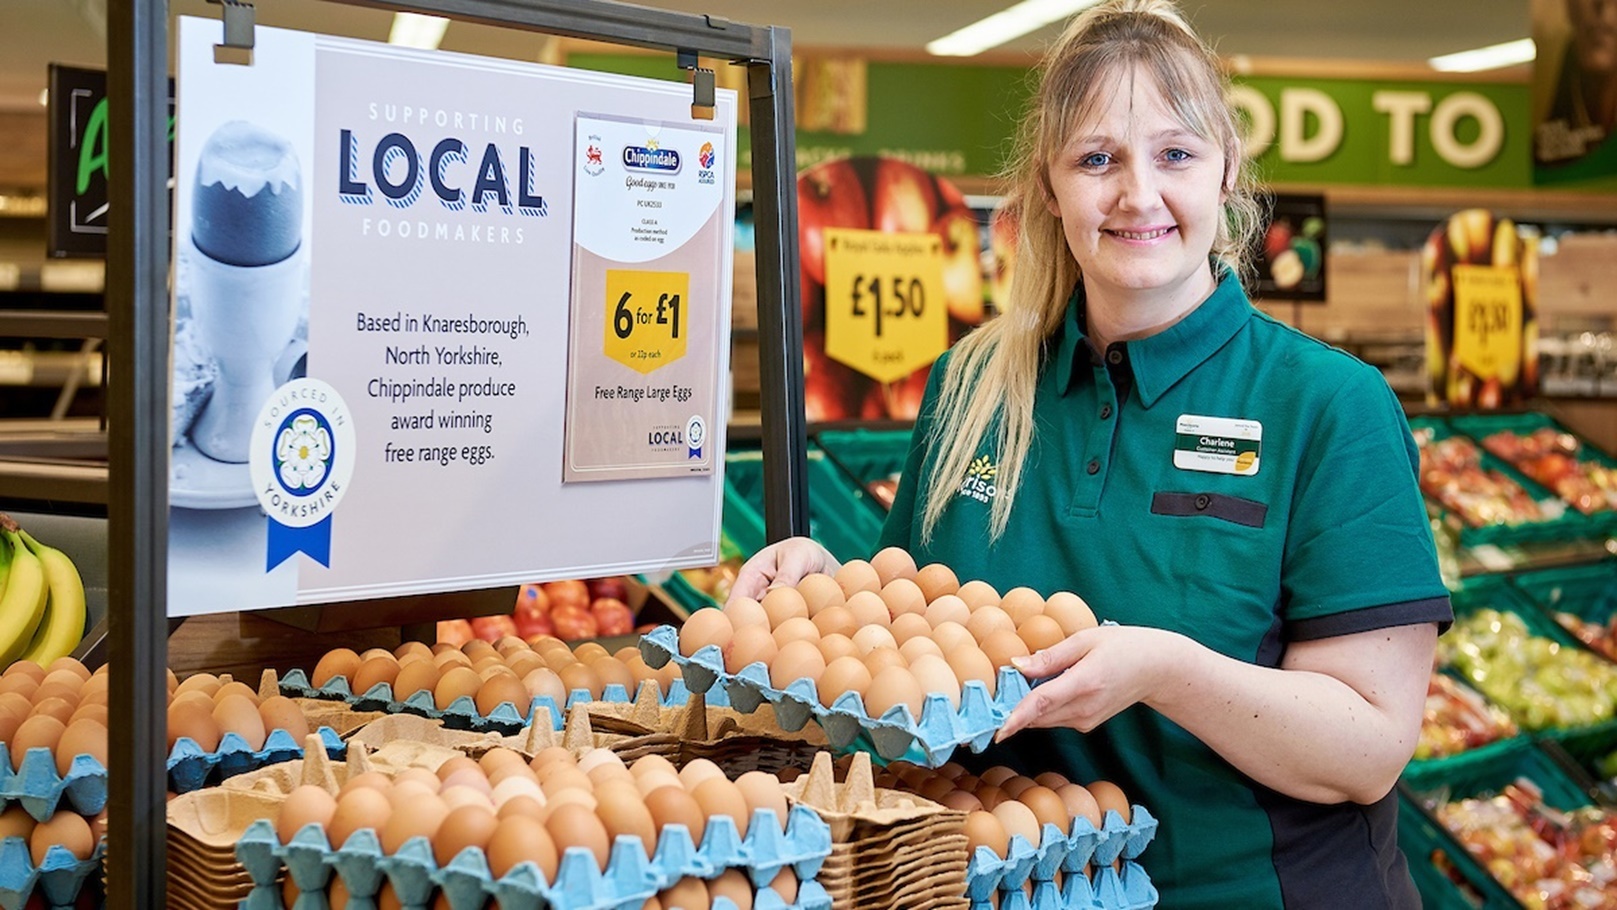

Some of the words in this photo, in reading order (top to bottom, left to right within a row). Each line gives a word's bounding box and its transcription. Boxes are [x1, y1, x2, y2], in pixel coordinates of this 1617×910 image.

[369, 102, 524, 135] SUPPORTING
[1372, 90, 1504, 168] TO
[624, 147, 677, 168] Chippindale
[339, 128, 548, 217] LOCAL
[625, 176, 644, 191] Good
[362, 218, 524, 244] FOODMAKERS
[614, 291, 634, 339] 6
[636, 307, 653, 325] for
[656, 293, 680, 339] £1
[851, 275, 926, 338] £1.50
[357, 312, 401, 332] Based
[405, 314, 418, 332] in
[422, 314, 530, 340] Knaresborough,
[385, 345, 430, 365] North
[435, 345, 502, 367] Yorkshire,
[648, 350, 661, 358] each
[367, 377, 455, 403] Chippindale
[459, 377, 516, 402] produce
[595, 386, 615, 400] Free
[616, 386, 645, 402] Range
[646, 385, 671, 402] Large
[673, 384, 692, 402] Eggs
[264, 388, 327, 428] SOURCED
[331, 407, 345, 427] IN
[391, 409, 434, 429] award
[438, 411, 492, 433] winning
[648, 431, 683, 445] LOCAL
[1200, 436, 1235, 447] Charlene
[385, 442, 414, 462] free
[419, 447, 457, 466] range
[461, 445, 495, 465] eggs.
[264, 481, 340, 517] YORKSHIRE
